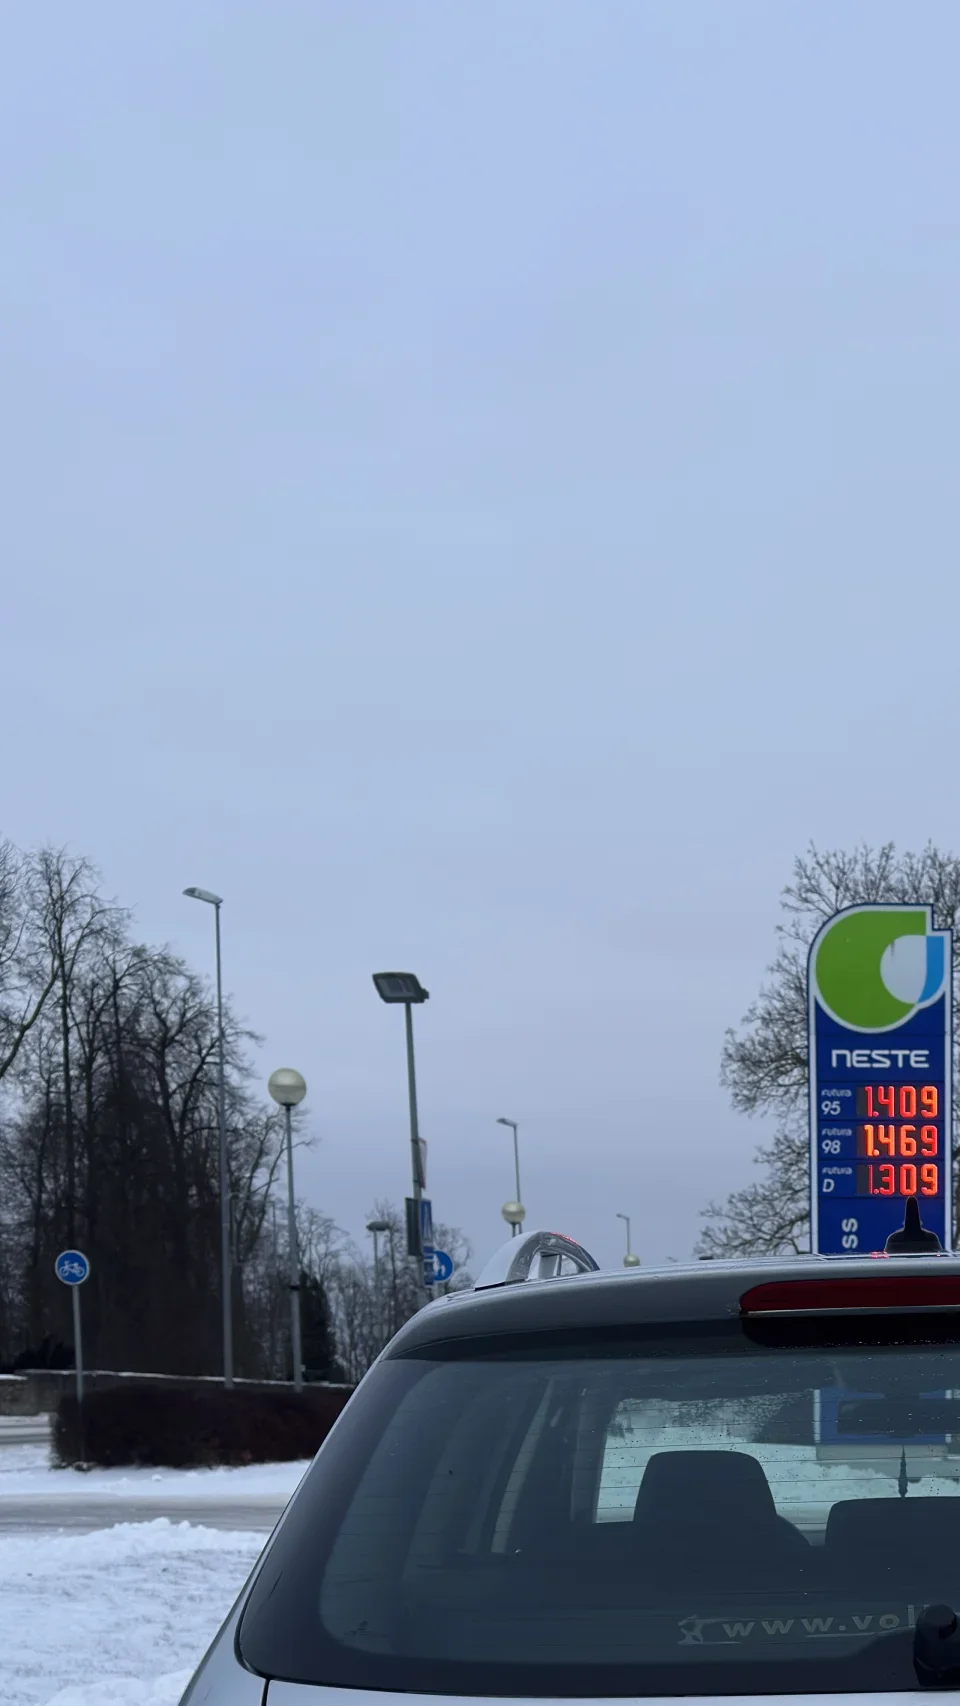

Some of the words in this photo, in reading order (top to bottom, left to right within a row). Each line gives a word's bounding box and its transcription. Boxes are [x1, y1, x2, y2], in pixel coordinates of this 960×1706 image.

[831, 1049, 930, 1068] NESTE
[821, 1100, 841, 1115] 95
[864, 1086, 938, 1118] 1.409
[821, 1139, 841, 1154] 98
[863, 1124, 938, 1157] 1.469
[822, 1178, 835, 1193] D
[866, 1163, 938, 1196] 1.309
